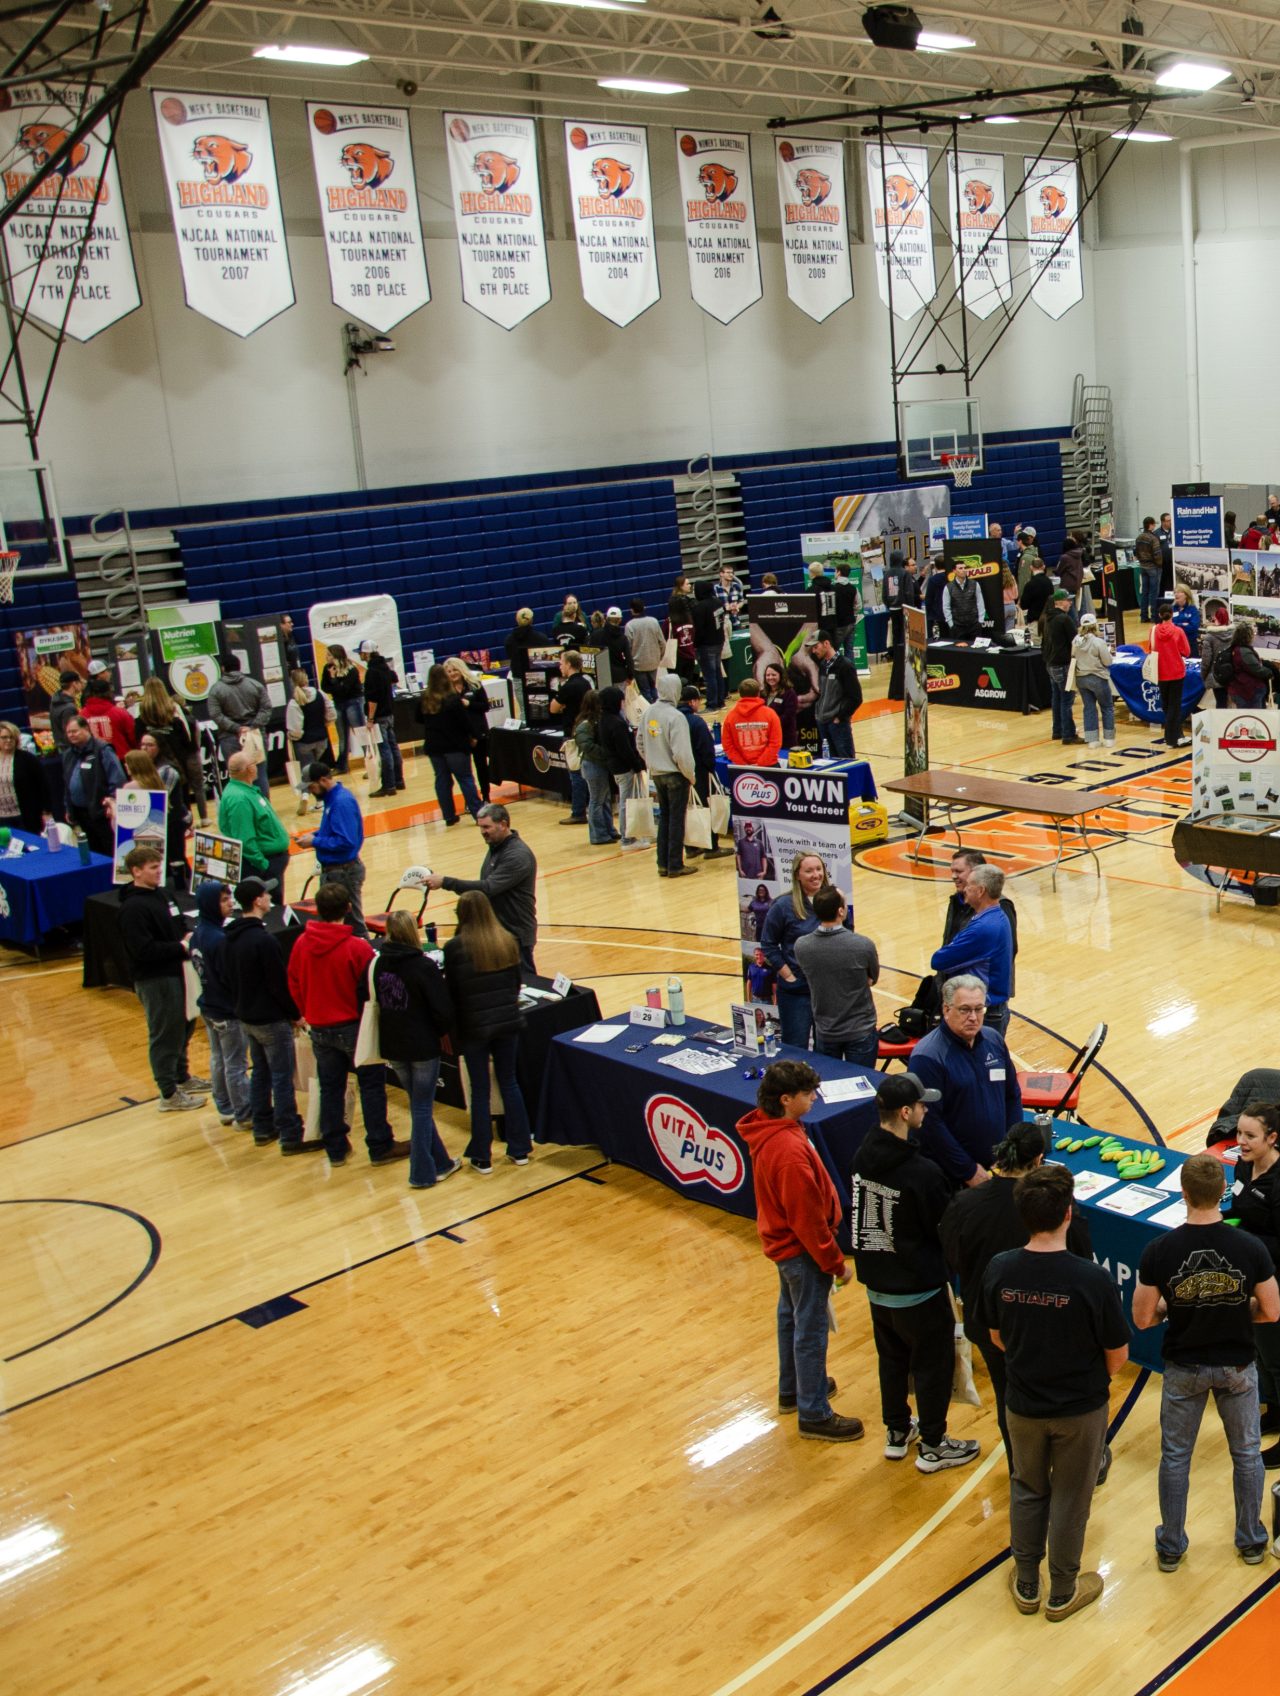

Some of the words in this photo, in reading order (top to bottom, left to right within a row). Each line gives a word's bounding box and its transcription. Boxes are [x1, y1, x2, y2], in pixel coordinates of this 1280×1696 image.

[178, 181, 269, 209] HIGHLAND
[328, 186, 408, 213] HIGHLAND
[460, 191, 533, 216] HIGHLAND
[579, 196, 646, 220] HIGHLAND
[198, 209, 258, 219] COUGARS
[688, 200, 747, 222] HIGHLAND
[785, 203, 840, 225] HIGHLAND
[344, 213, 398, 222] COUGARS
[474, 216, 524, 224] COUGARS
[181, 228, 219, 243] NJCAA
[226, 228, 278, 243] NATIONAL
[330, 231, 363, 244] NJCAA
[369, 231, 415, 244] NATIONAL
[462, 233, 491, 246] NJCAA
[496, 234, 538, 247] NATIONAL
[579, 236, 608, 247] NJCAA
[612, 236, 650, 248] NATIONAL
[717, 238, 752, 250] NATIONAL
[194, 248, 268, 262] TOURNAMENT
[340, 248, 407, 262] TOURNAMENT
[472, 250, 530, 263] TOURNAMENT
[588, 252, 644, 263] TOURNAMENT
[696, 253, 744, 264] TOURNAMENT
[793, 254, 838, 264] TOURNAMENT
[222, 266, 249, 280] 2007
[364, 266, 390, 279] 2006
[608, 268, 628, 279] 2004
[714, 267, 731, 278] 2016
[351, 284, 371, 296] 3RD
[378, 284, 407, 296] PLACE
[480, 284, 498, 295] 6TH
[503, 284, 530, 295] PLACE
[1177, 507, 1191, 515] Rain
[1192, 506, 1204, 514] and
[1204, 506, 1217, 514] Hail
[323, 618, 357, 630] Energy
[163, 628, 196, 640] Nutrien
[926, 678, 954, 690] DEKALB
[974, 689, 1006, 699] ASGROW
[800, 727, 818, 740] Soil
[806, 743, 818, 752] Soil
[741, 782, 759, 792] VITA
[784, 777, 844, 804] OWN
[750, 790, 771, 800] PLUS
[118, 804, 134, 813] CORN
[136, 804, 146, 814] BELT
[786, 802, 808, 814] Your
[810, 804, 844, 816] Career
[776, 836, 794, 845] Work
[796, 838, 811, 846] with
[818, 841, 838, 850] team
[642, 1013, 652, 1022] 29
[660, 1112, 696, 1142] VITA
[680, 1140, 726, 1172] PLUS
[1002, 1288, 1071, 1308] STAFF
